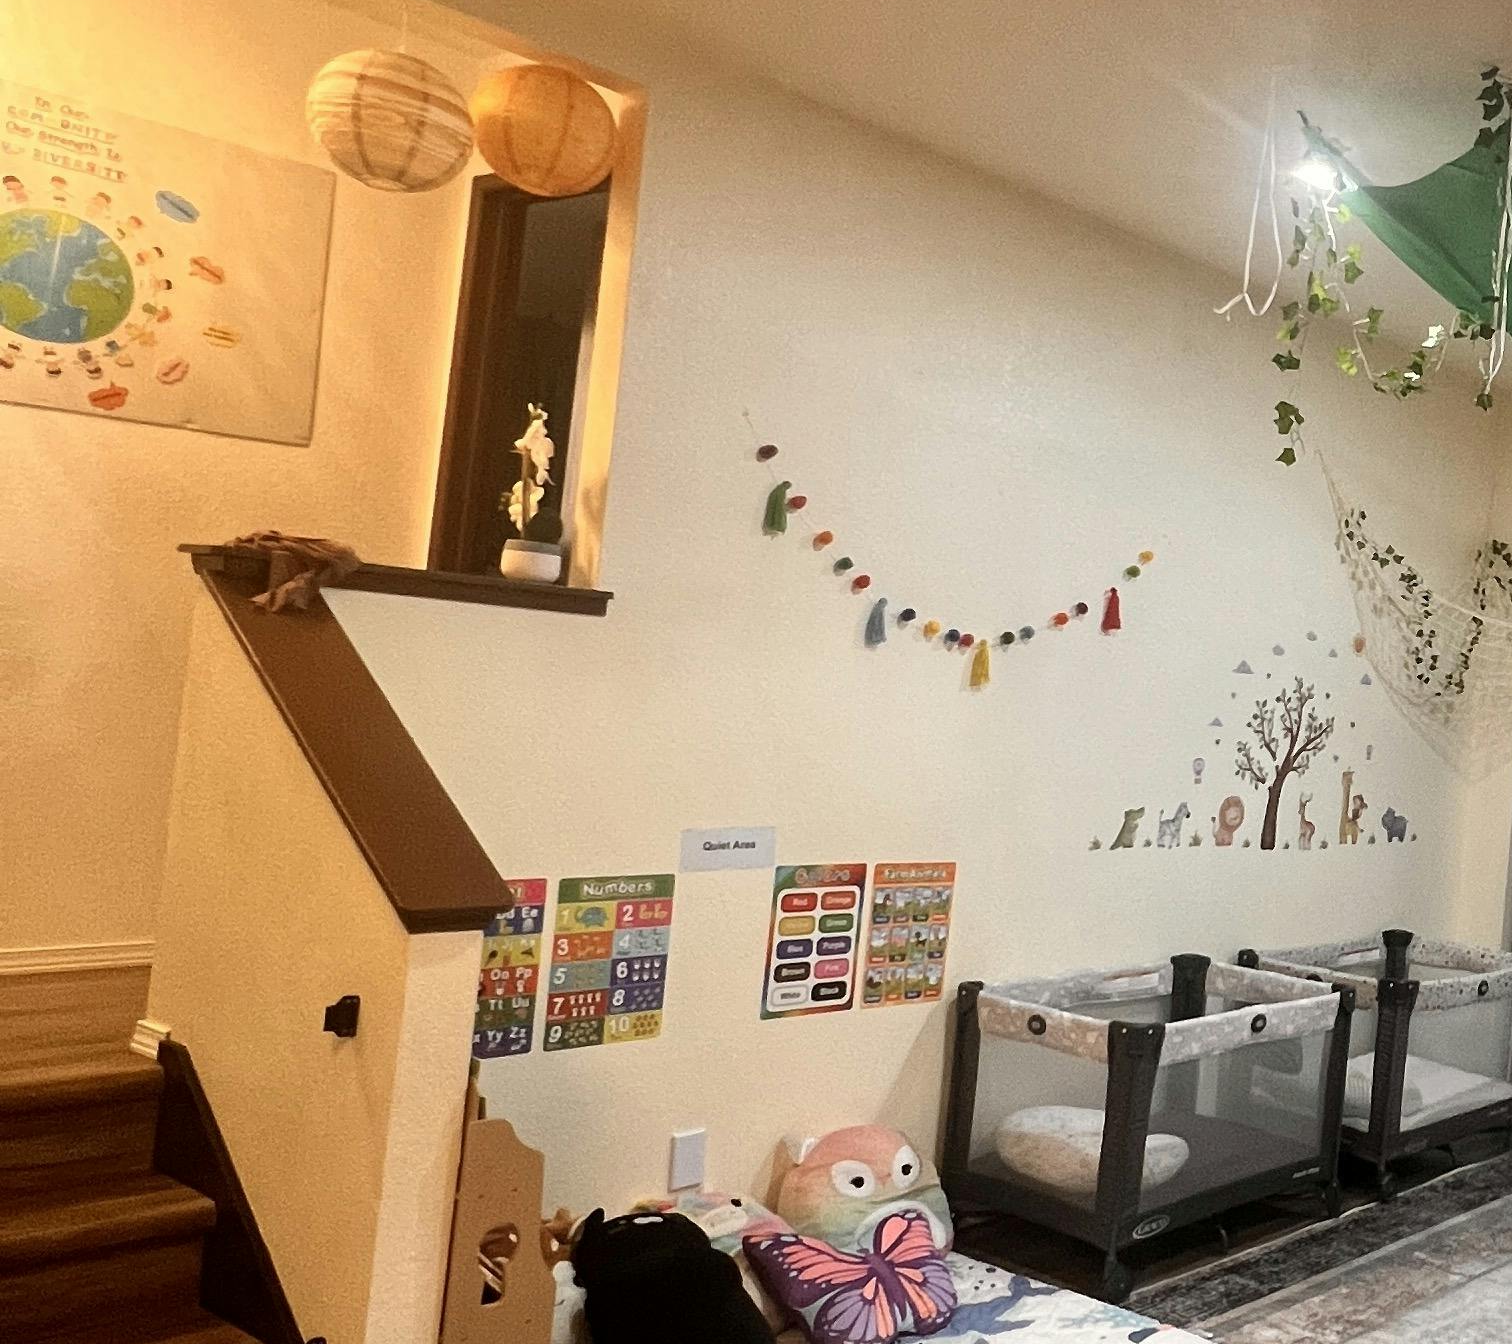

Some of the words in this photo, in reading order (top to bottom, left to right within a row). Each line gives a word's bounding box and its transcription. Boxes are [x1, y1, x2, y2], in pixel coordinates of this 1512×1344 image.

[703, 841, 730, 850] Quiet
[732, 840, 755, 849] Area
[583, 881, 653, 896] Numbers
[622, 905, 634, 921] 2
[557, 939, 569, 956] 3
[619, 934, 631, 949] 4
[553, 967, 568, 984] 5
[617, 961, 628, 978] 6
[553, 997, 565, 1014] 7
[613, 989, 626, 1006] 8
[549, 1026, 562, 1043] 9
[609, 1017, 630, 1034] 10
